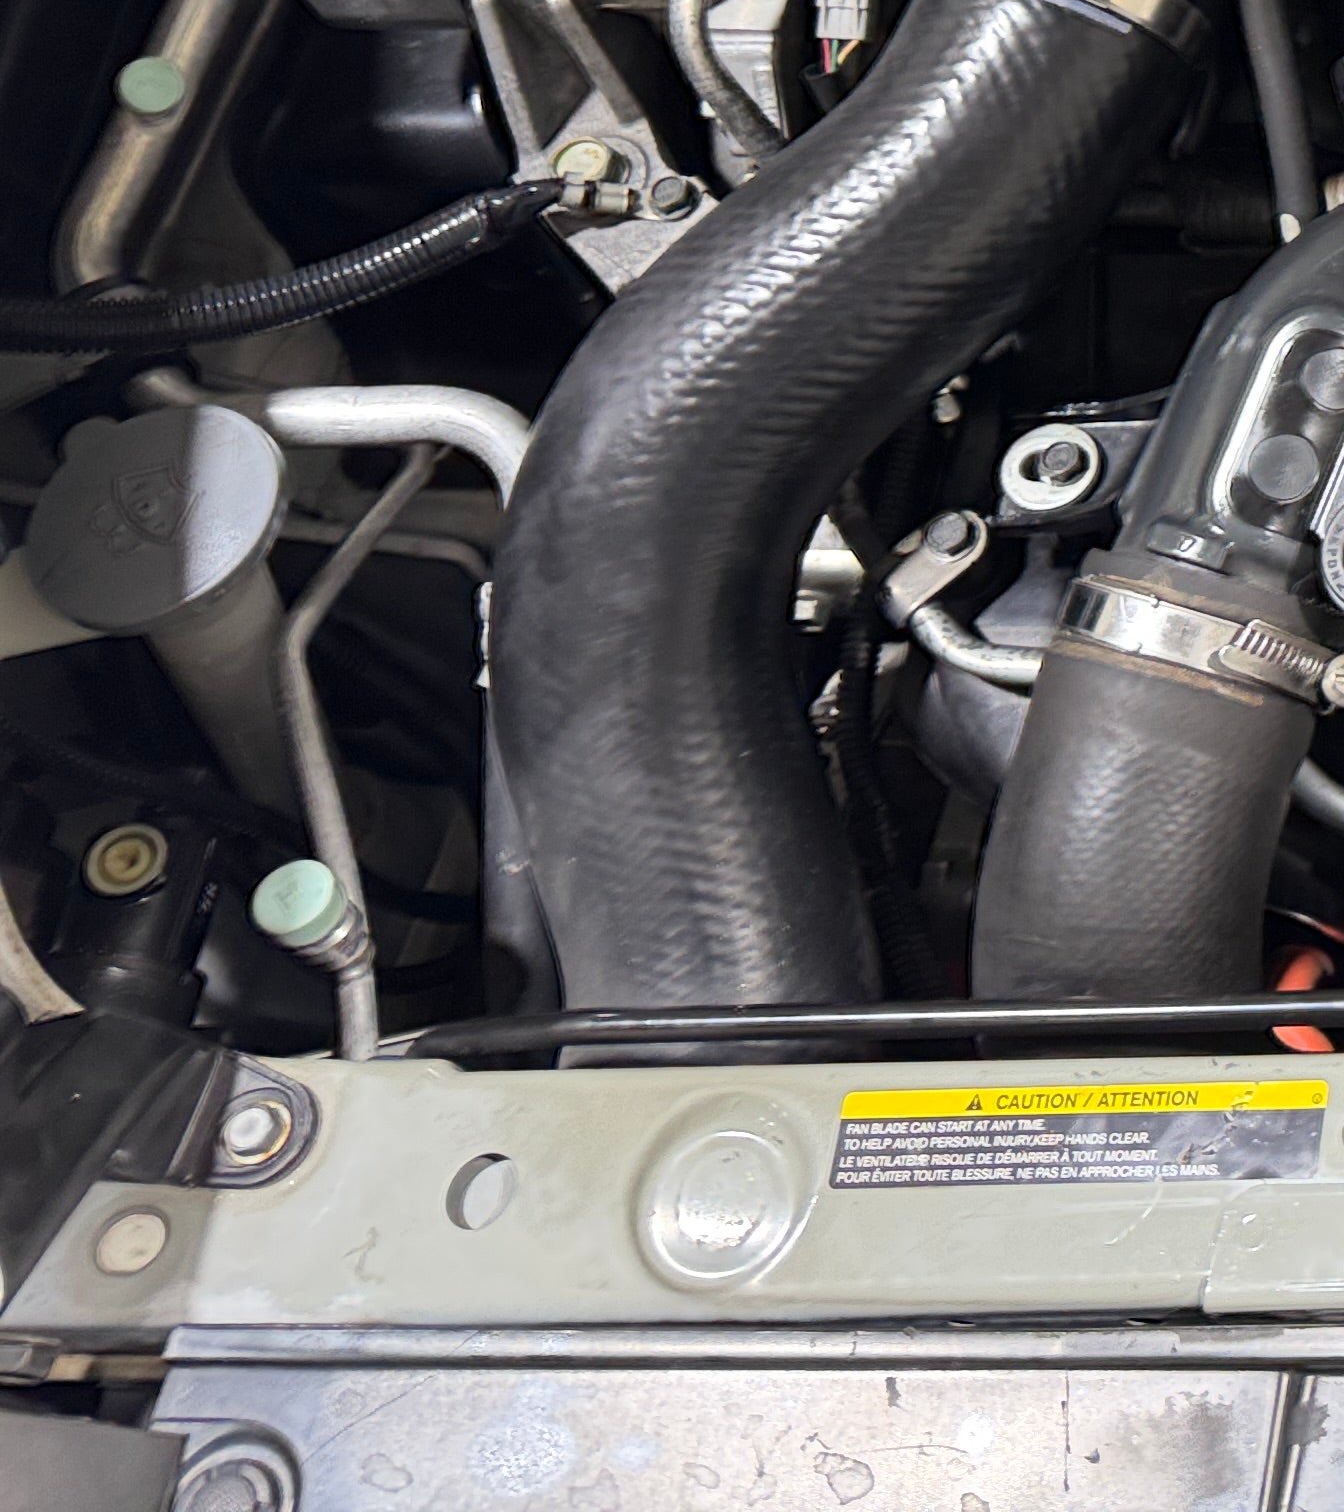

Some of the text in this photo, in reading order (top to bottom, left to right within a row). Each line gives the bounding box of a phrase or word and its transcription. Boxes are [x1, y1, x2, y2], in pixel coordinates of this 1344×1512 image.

[996, 1090, 1199, 1110] CAUTION / ATTENTION
[846, 1119, 1046, 1134] FAN BLADE CAN START AT ANY TIME.
[844, 1138, 861, 1150] TO
[862, 1138, 893, 1150] HELP
[892, 1138, 929, 1150] AVOID
[929, 1137, 992, 1149] PERSONAL
[1064, 1133, 1108, 1145] HANDS
[1108, 1132, 1150, 1144] CLEAR.
[840, 1148, 1158, 1168] LE VENTILATEUR RISQUE DE DÉMARRER À TOUT MOMENT.
[836, 1164, 1220, 1183] POUR ÉVITER TOUTE BLESSURE, NE PAS EN APPROCHER LES MAINS.
